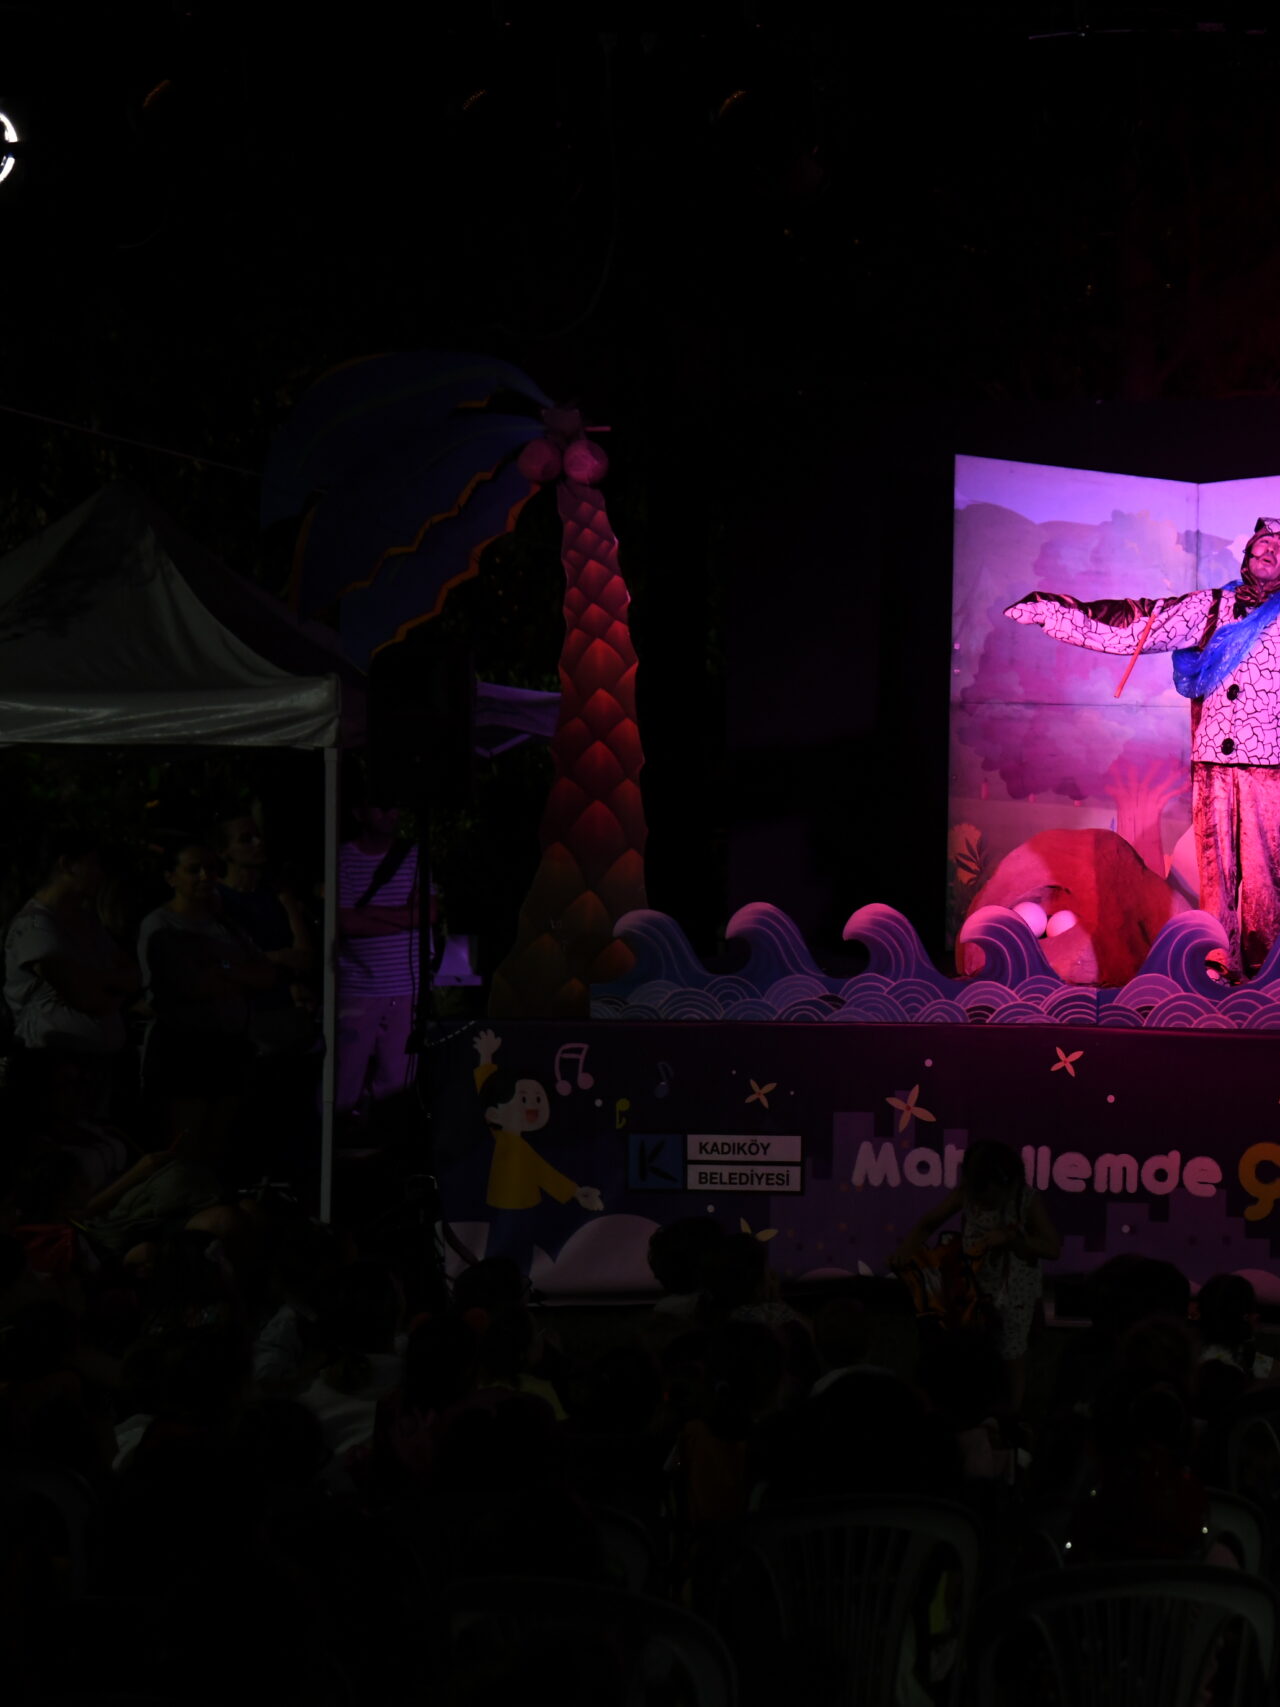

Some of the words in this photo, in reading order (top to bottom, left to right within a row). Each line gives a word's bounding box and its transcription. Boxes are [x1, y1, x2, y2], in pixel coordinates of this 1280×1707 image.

[698, 1139, 771, 1156] KADIKÖY
[851, 1139, 1223, 1198] Mallemde
[698, 1169, 790, 1186] BELEDİYESİ
